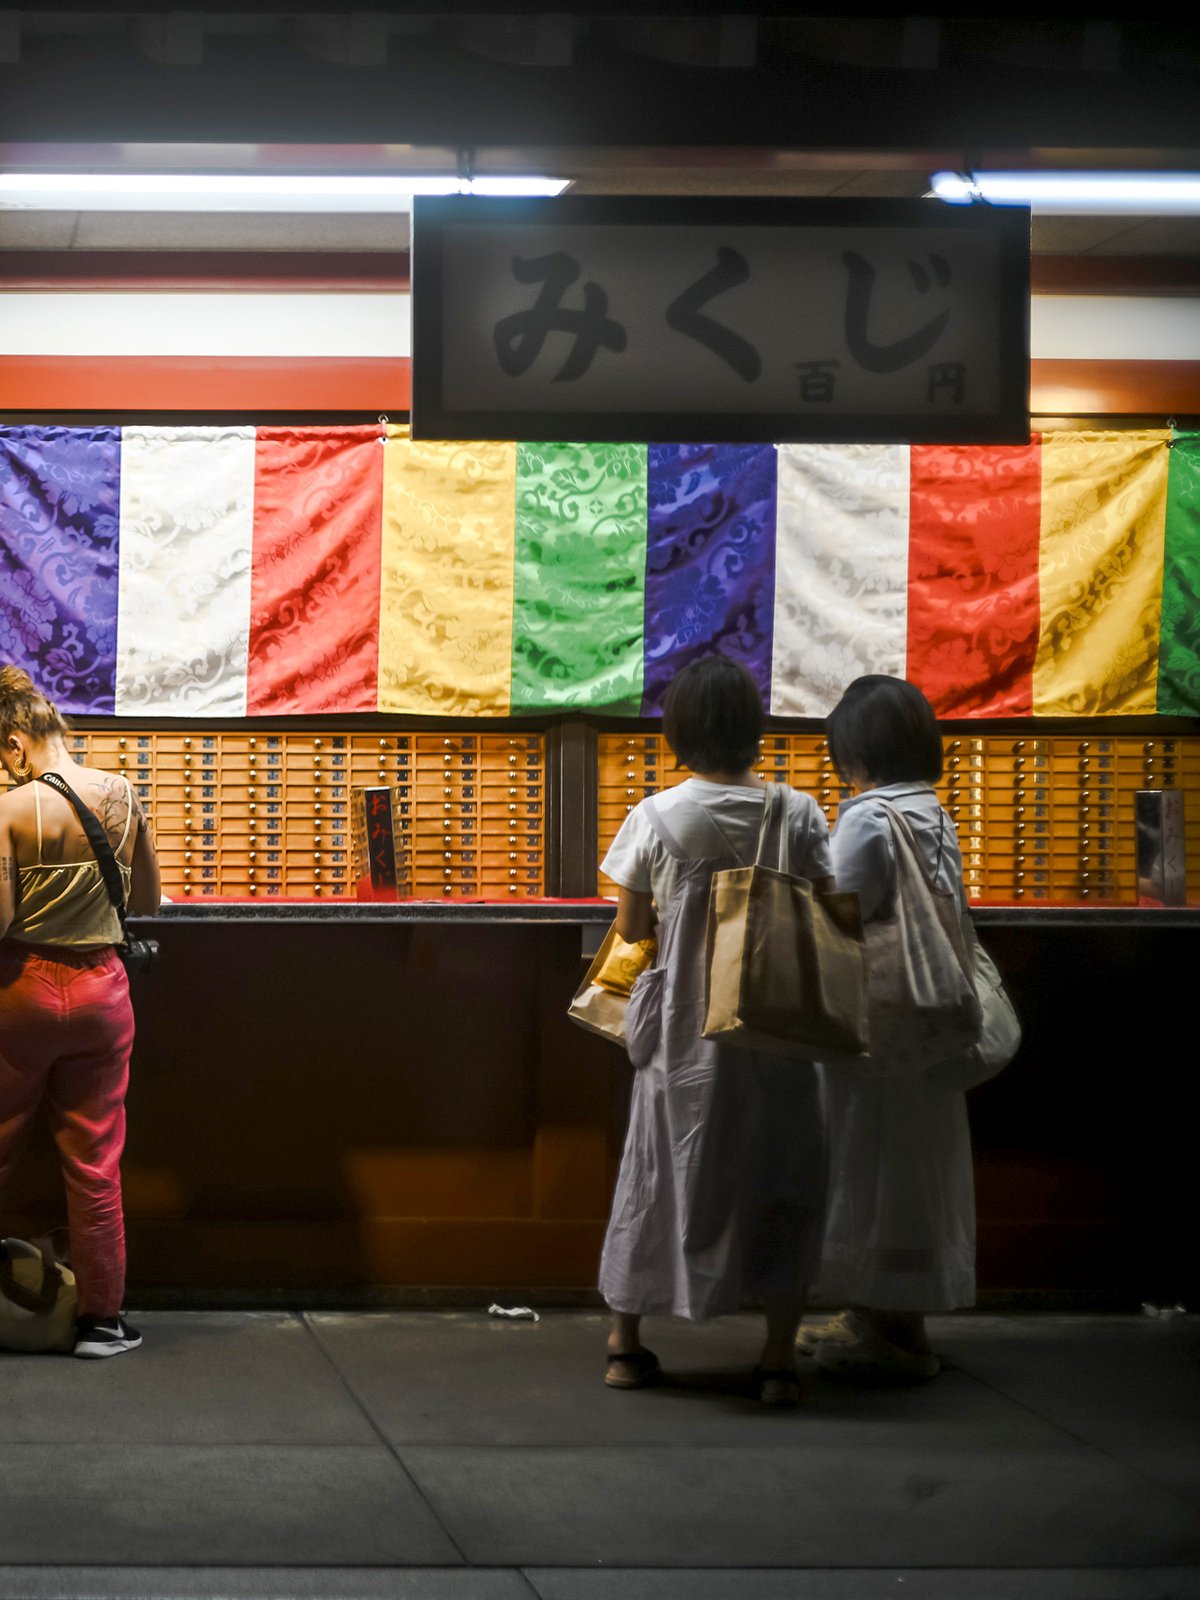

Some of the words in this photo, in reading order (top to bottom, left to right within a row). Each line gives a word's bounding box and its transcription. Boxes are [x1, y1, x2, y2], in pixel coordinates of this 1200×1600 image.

[493, 246, 953, 384] みくじ
[371, 793, 392, 890] おみくじ
